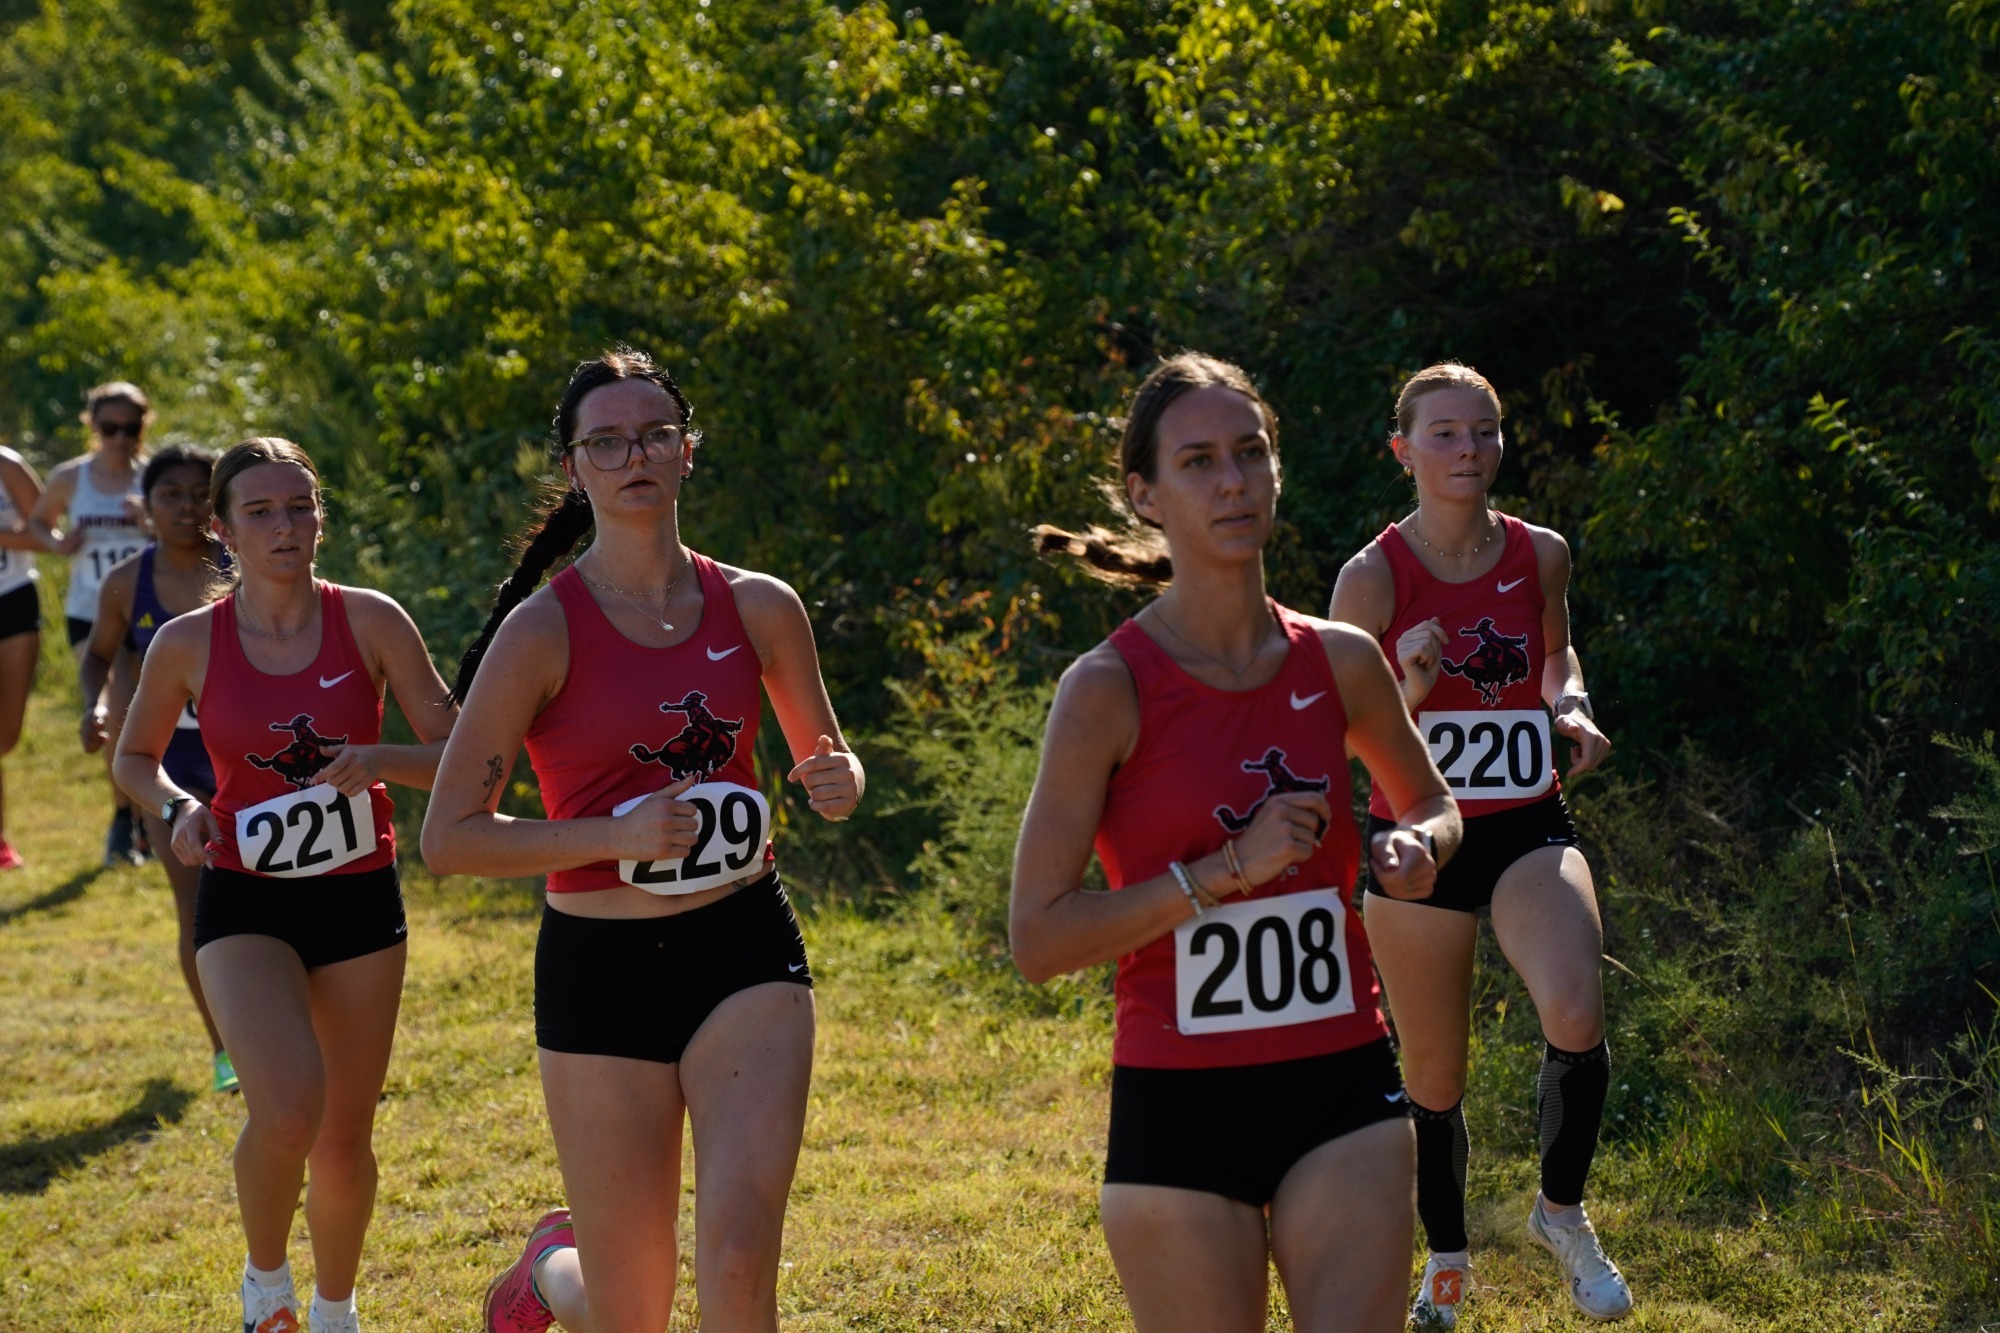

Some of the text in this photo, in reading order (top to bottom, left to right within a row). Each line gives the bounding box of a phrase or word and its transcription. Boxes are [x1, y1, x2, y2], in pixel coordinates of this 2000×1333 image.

[1428, 720, 1543, 788] 220
[246, 789, 358, 873] 221
[1189, 907, 1341, 1019] 208
